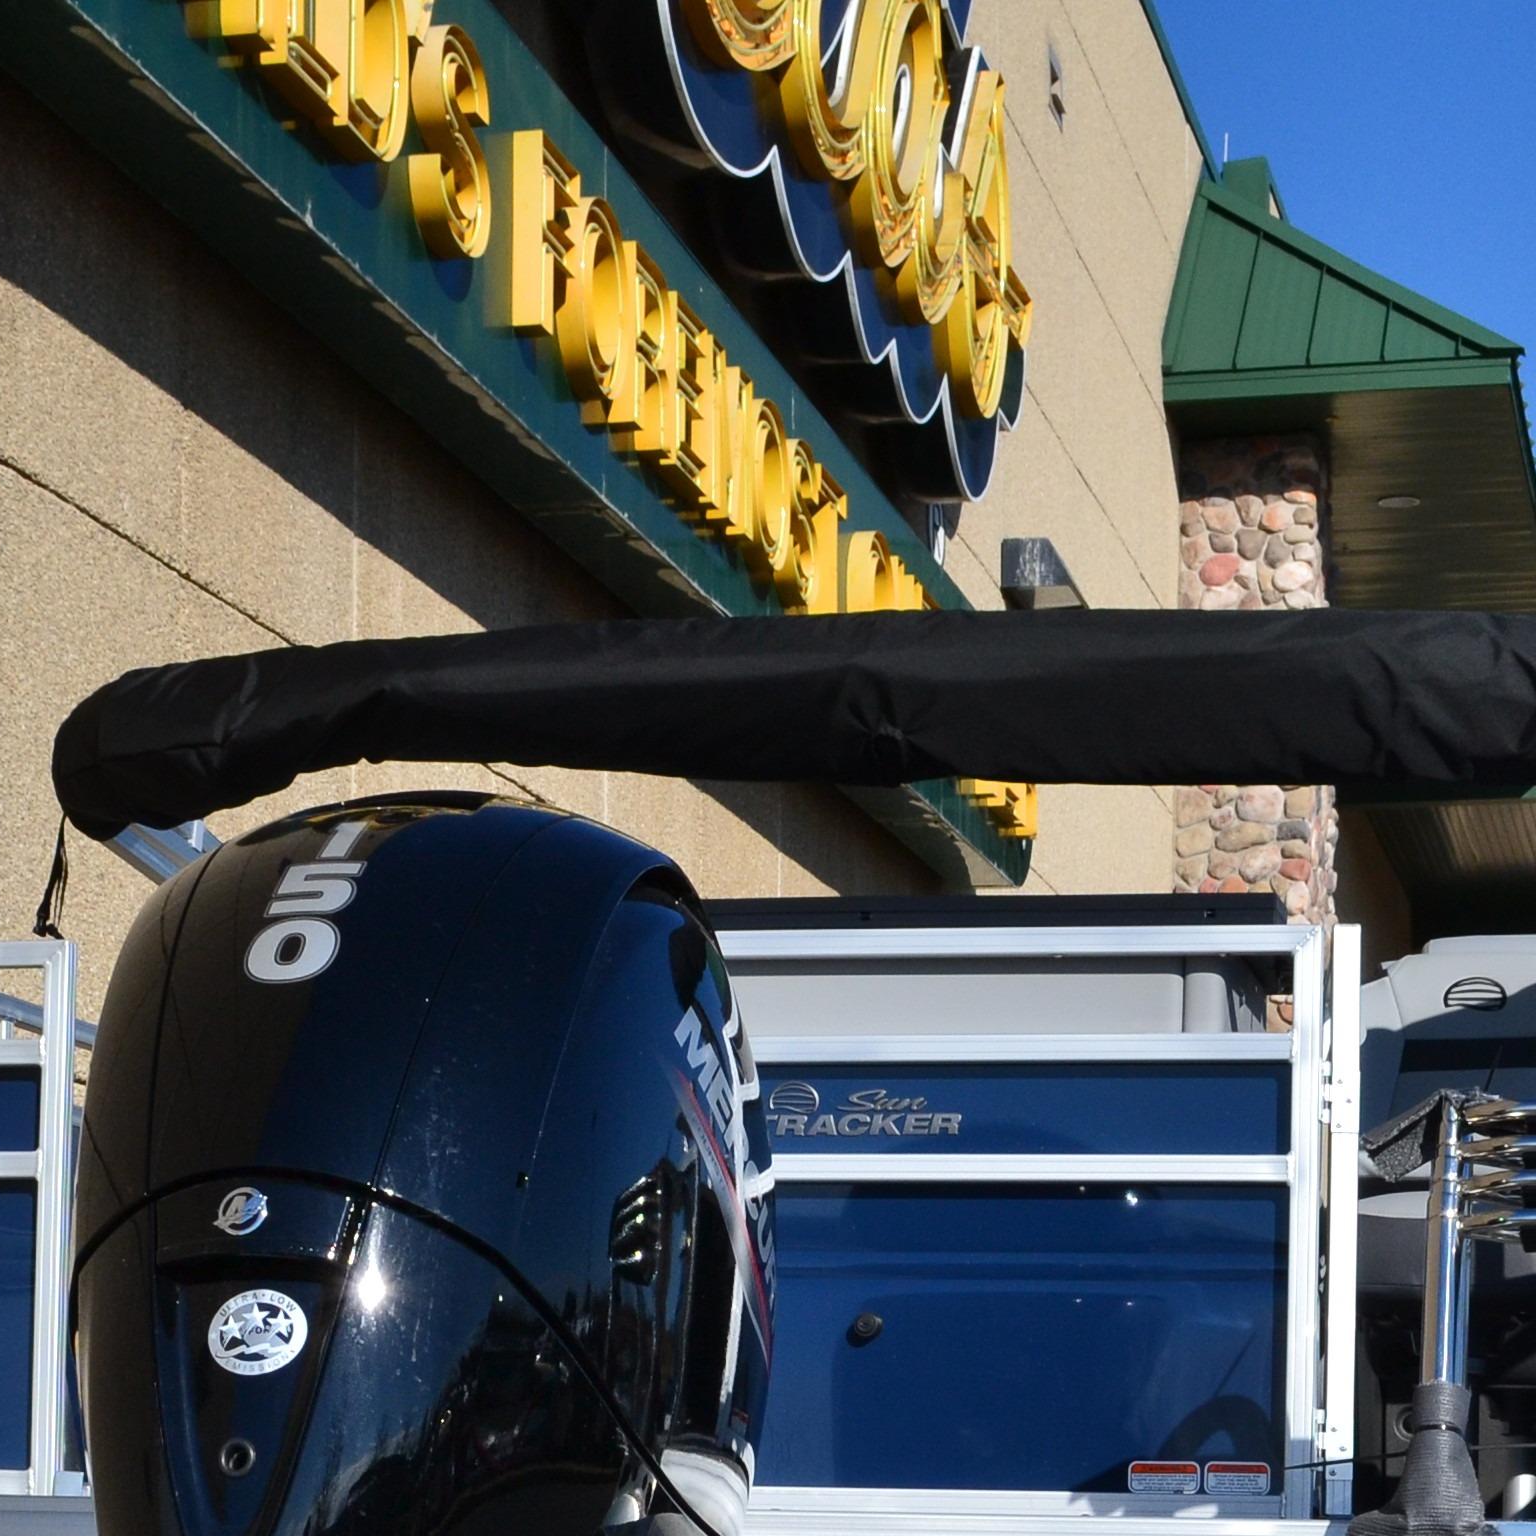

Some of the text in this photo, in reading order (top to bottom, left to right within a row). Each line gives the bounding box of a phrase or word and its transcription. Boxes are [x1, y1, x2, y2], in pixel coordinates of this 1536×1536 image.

[512, 129, 847, 617] FOREMOST
[244, 821, 368, 983] 150
[674, 1006, 777, 1320] MERCUR
[837, 1088, 928, 1112] Sun
[219, 1293, 297, 1318] ULTRA LOW
